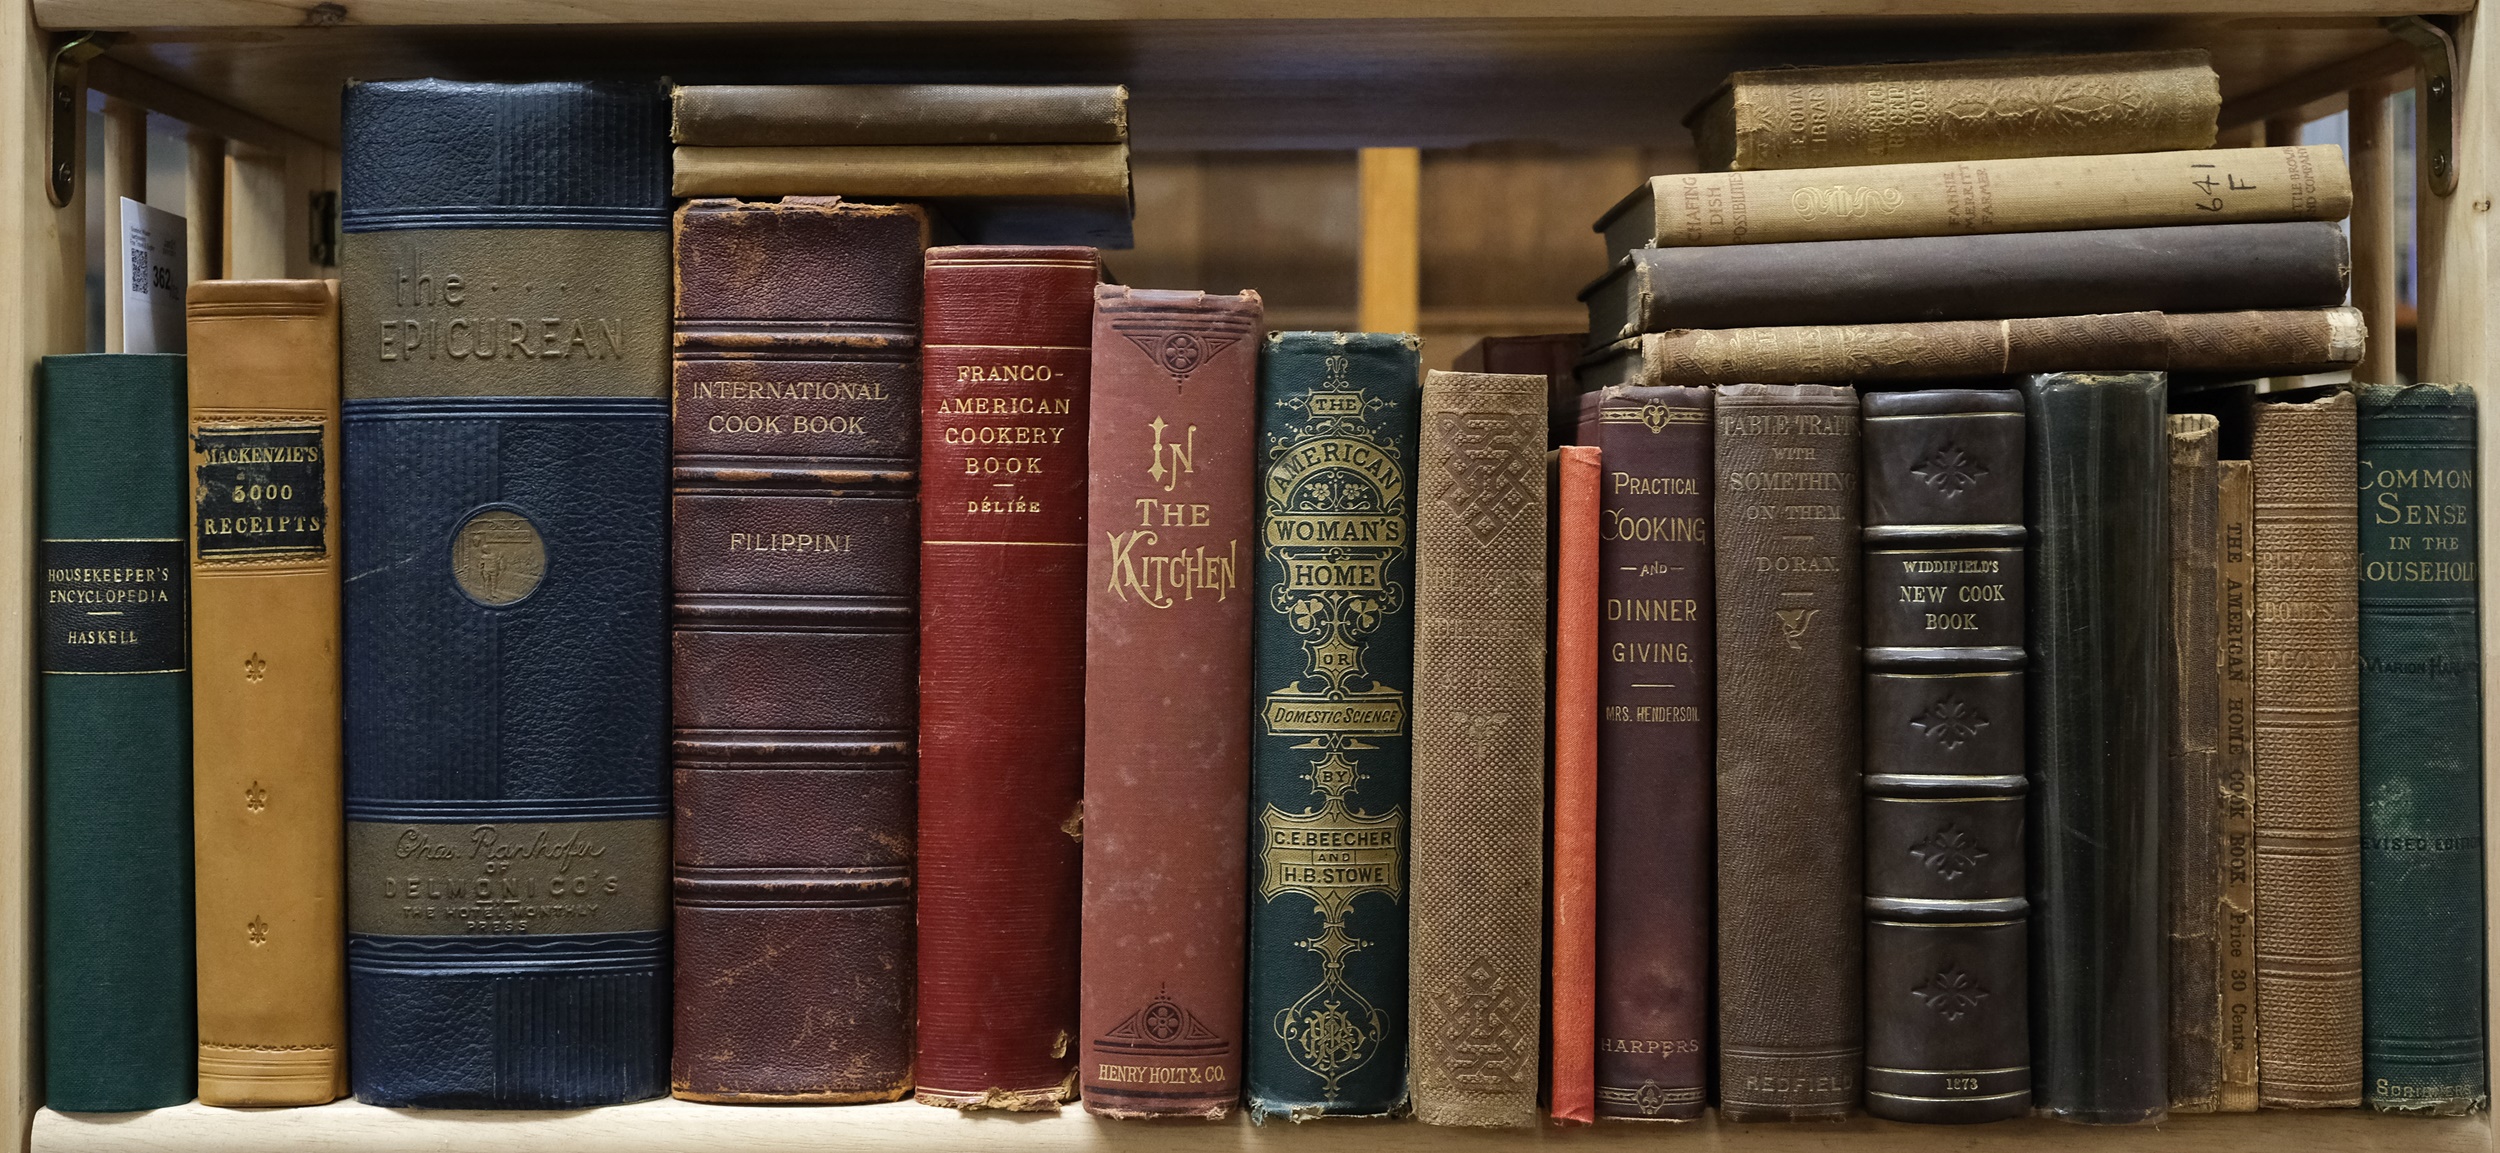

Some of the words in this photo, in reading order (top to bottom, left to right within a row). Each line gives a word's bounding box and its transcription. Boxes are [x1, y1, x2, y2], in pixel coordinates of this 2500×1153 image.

[2191, 164, 2223, 212] 641
[2228, 173, 2256, 191] F
[1707, 187, 1724, 226] DISH
[1944, 172, 1960, 227] FANNIE
[1977, 169, 1993, 226] FARMER
[2290, 182, 2303, 213] TTLE
[1681, 177, 1702, 242] CHAFING
[1728, 173, 1747, 244] POSSIBILITIES
[379, 317, 625, 361] EPICUREAN
[956, 365, 1064, 382] FRANCO-
[692, 381, 890, 401] INTERNATIONAL
[937, 397, 1071, 415] AMERICAN
[1315, 398, 1358, 412] THE
[708, 415, 783, 434] COOK
[792, 415, 866, 434] BOOK
[1795, 414, 1858, 437] TRAIT
[944, 426, 1065, 444] COOKERY
[204, 445, 320, 465] MACKENZIE'S
[1146, 415, 1198, 492] IN
[1772, 447, 1816, 460] WITH
[964, 456, 1043, 474] BOOK
[1271, 442, 1401, 494] AMERICAN
[1611, 472, 1700, 495] PRACTICAL
[1729, 471, 1857, 491] SOMETHING
[232, 484, 294, 504] 5000
[1134, 498, 1211, 527] THE
[1746, 505, 1776, 520] ON
[1784, 505, 1846, 520] THEM.
[2375, 492, 2468, 525] SENSE
[204, 515, 321, 535] RECEIPTS
[1274, 517, 1400, 542] WOMAN'S
[1600, 507, 1706, 545] COOKING
[729, 533, 852, 552] FILIPPINI
[2227, 523, 2244, 564] THE
[2389, 536, 2412, 551] IN
[2421, 536, 2460, 551] THE
[48, 566, 170, 583] HOUSEKEEPER'S
[1105, 530, 1238, 609] KITCHEN
[1294, 564, 1376, 587] HOME
[1639, 560, 1669, 577] AND
[1902, 560, 2000, 573] WIDDIFIELD'S
[49, 589, 169, 604] ENCYCLOPEDIA
[1899, 585, 1948, 604] NEW
[1958, 584, 2006, 603] COOK
[1607, 599, 1698, 622] DINNER
[1925, 613, 1979, 630] BOOK
[2227, 578, 2244, 682] AMERICAN
[67, 630, 139, 645] HASKELL
[1322, 652, 1351, 666] OR
[1274, 707, 1342, 725] DOMESTIC
[1342, 706, 1398, 724] SCIENCE
[1605, 705, 1634, 723] MRS.
[2228, 698, 2245, 756] HOME
[1322, 770, 1348, 783] BY
[2361, 838, 2426, 851] EVISED
[485, 861, 511, 874] OF
[1317, 852, 1351, 863] AND
[384, 869, 620, 900] DELMONICO'S
[403, 905, 435, 919] THE
[446, 905, 503, 919] HOTEL
[511, 904, 599, 919] MONTHLY
[466, 919, 529, 933] PRESS
[2229, 913, 2246, 957] Price
[2231, 970, 2247, 993] 30
[2231, 1003, 2248, 1056] Cents.
[1601, 1038, 1700, 1054] HARPERS
[1098, 1064, 1149, 1084] HENRY
[1148, 1066, 1188, 1084] HOLT
[1189, 1067, 1203, 1084] &
[1204, 1065, 1226, 1083] CO.
[1945, 1077, 1979, 1091] 1873
